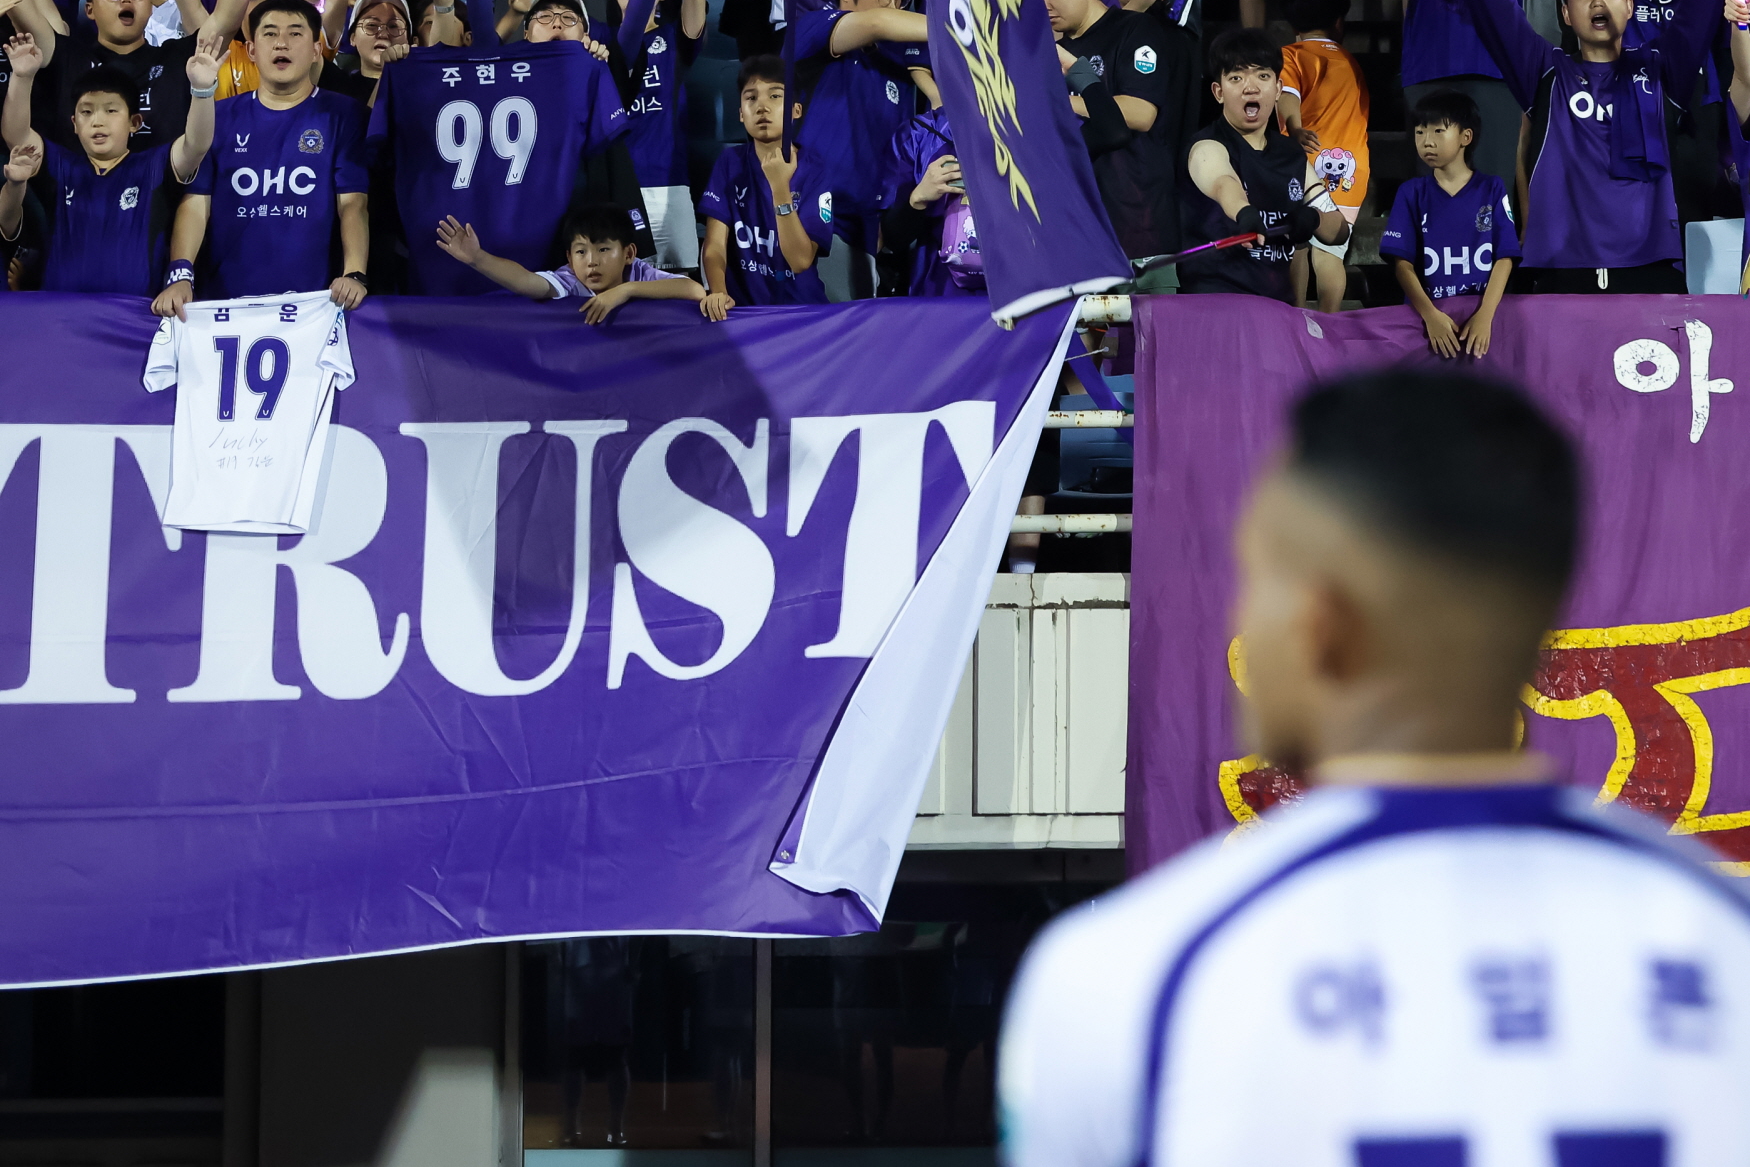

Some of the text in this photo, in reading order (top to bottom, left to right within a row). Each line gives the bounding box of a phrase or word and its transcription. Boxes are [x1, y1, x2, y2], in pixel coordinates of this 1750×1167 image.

[441, 62, 531, 87] 주현우
[435, 95, 538, 190] 99
[231, 165, 316, 196] OHC
[734, 219, 779, 258] OH
[214, 335, 291, 422] 19
[0, 400, 997, 704] TRUST
